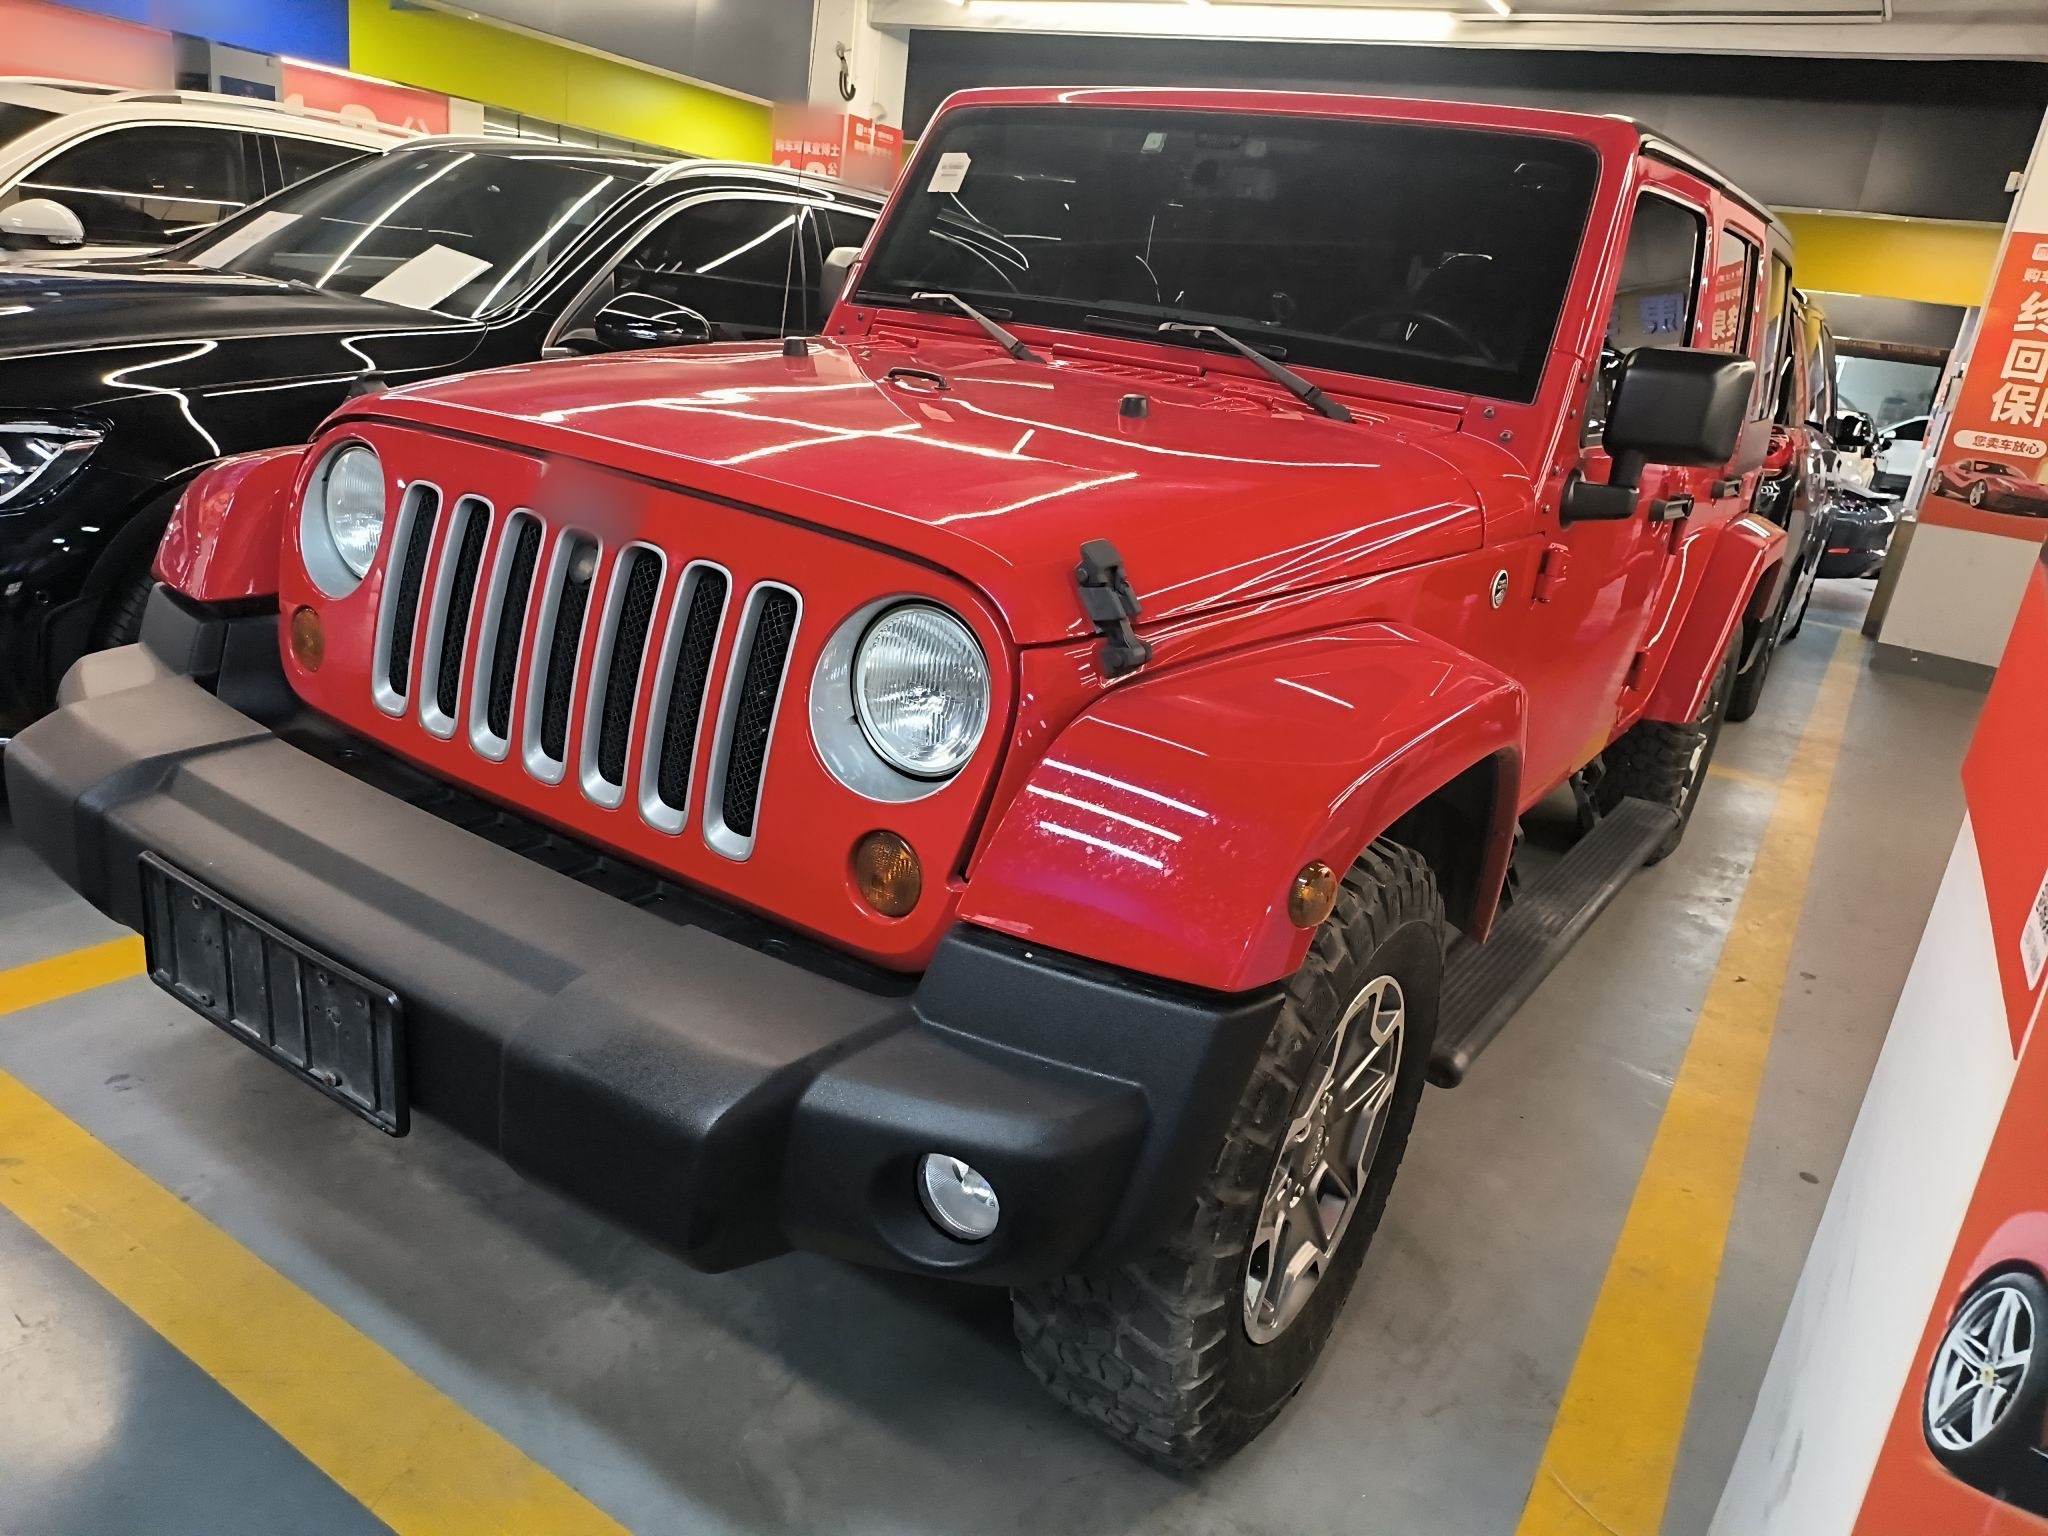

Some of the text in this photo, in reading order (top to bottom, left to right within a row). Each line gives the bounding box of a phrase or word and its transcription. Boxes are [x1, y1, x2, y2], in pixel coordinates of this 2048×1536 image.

[1972, 435, 2040, 455] 您卖车放心
